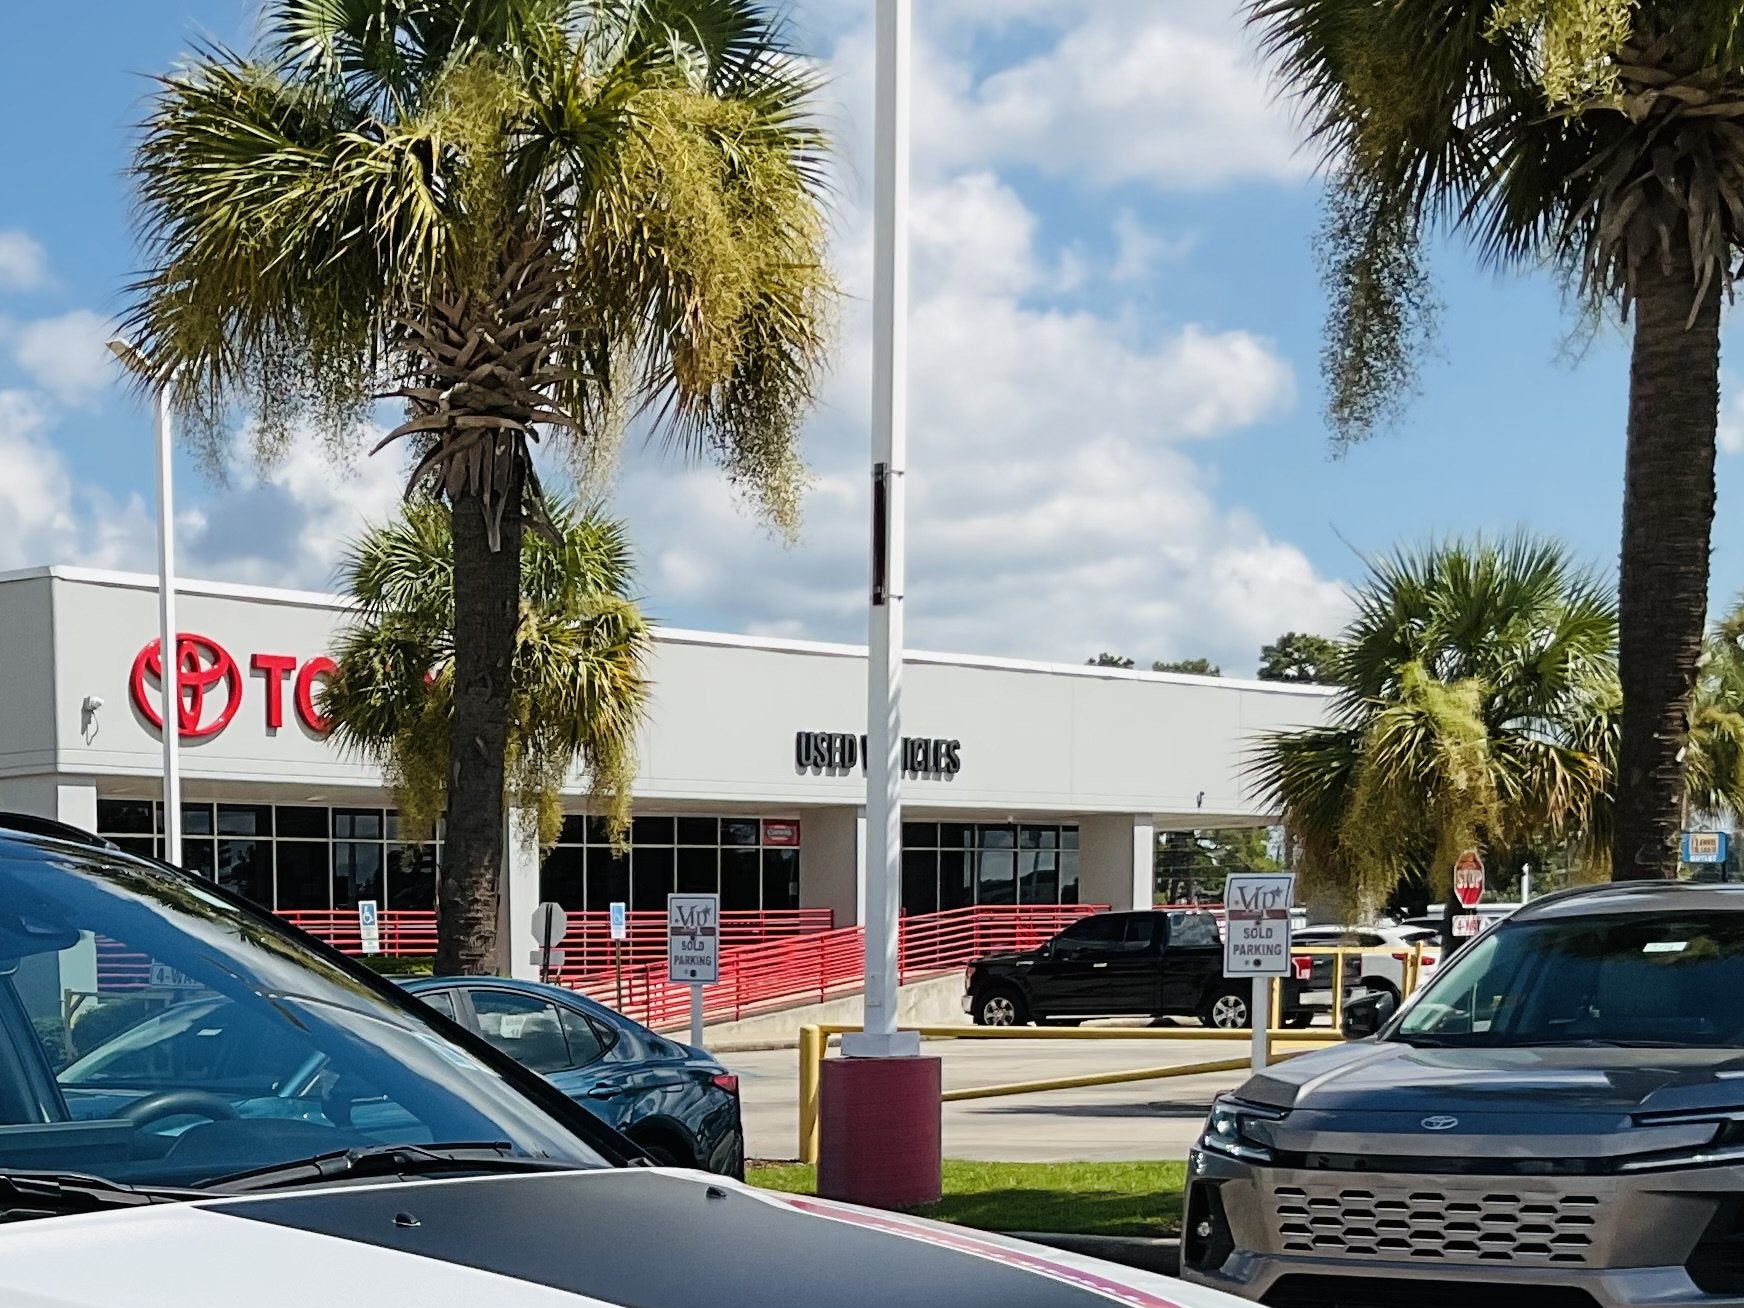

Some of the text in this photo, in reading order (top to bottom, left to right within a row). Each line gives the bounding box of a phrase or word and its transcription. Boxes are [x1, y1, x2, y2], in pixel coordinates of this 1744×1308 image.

[795, 732, 857, 769] USED
[1457, 869, 1482, 889] STOP
[1243, 927, 1273, 939] SOLD
[681, 940, 705, 951] SOLD
[1233, 943, 1282, 956] PARKING
[674, 955, 712, 966] PARKING
